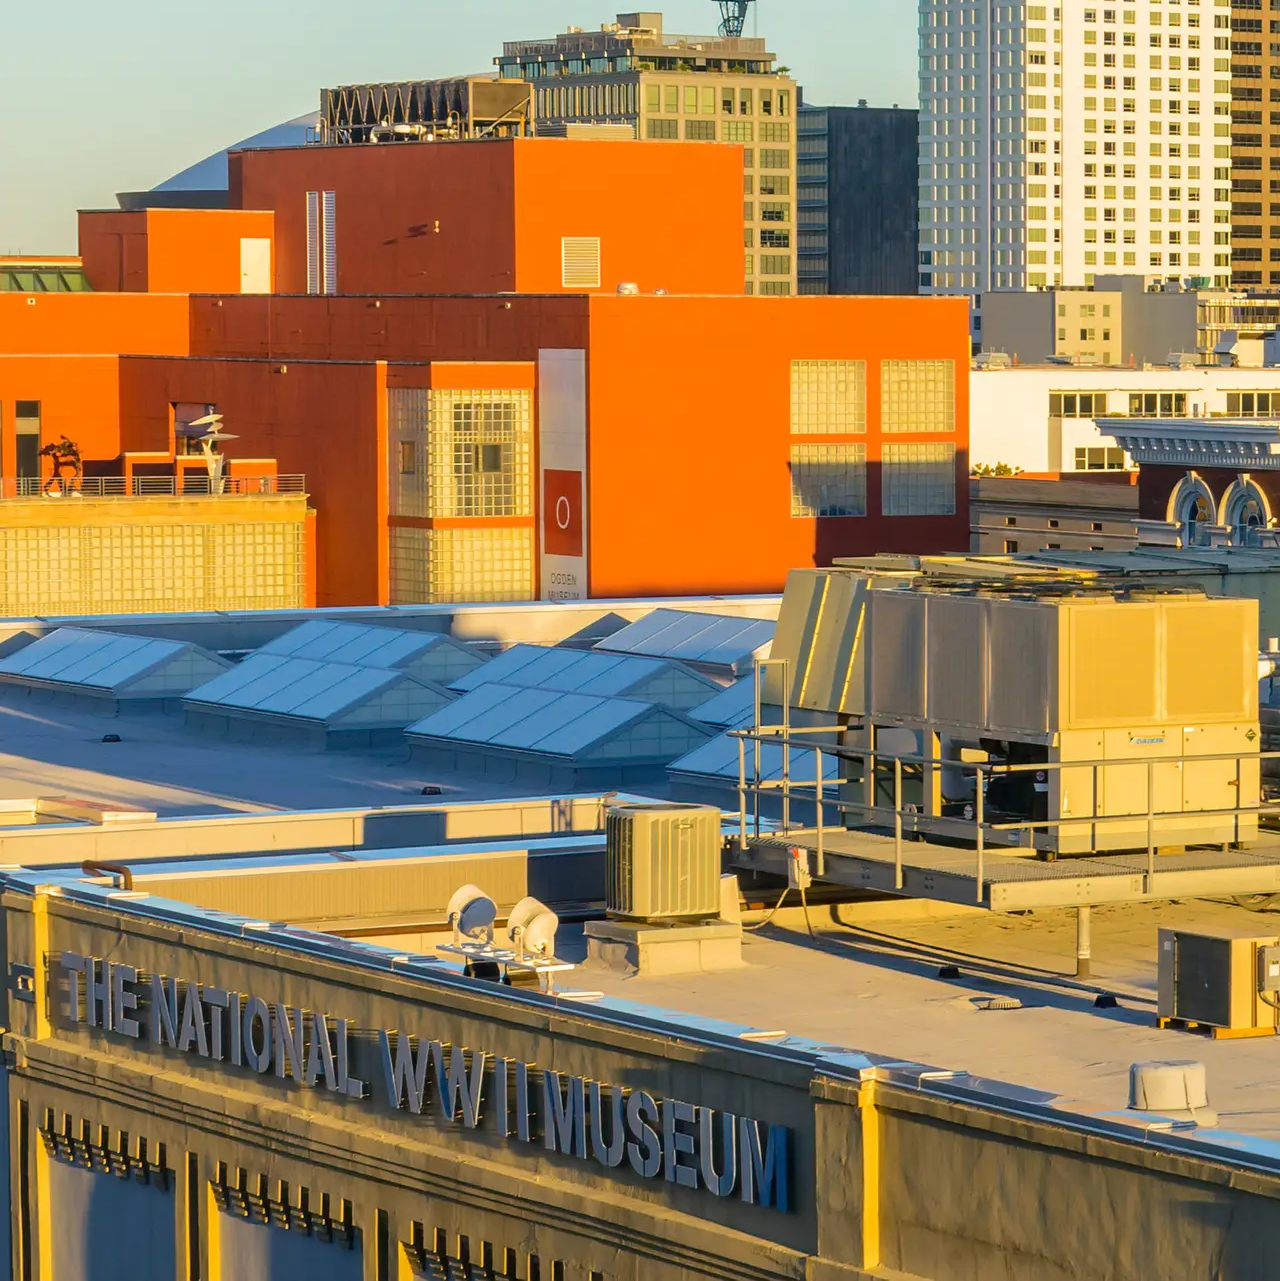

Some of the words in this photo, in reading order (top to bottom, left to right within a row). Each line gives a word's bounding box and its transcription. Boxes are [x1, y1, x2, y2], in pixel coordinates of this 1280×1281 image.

[550, 572, 578, 586] OGDEN
[60, 950, 139, 1038] THE
[151, 973, 366, 1100] NATIONAL
[378, 1028, 530, 1143] WWII
[544, 1068, 789, 1214] MUSEUM
